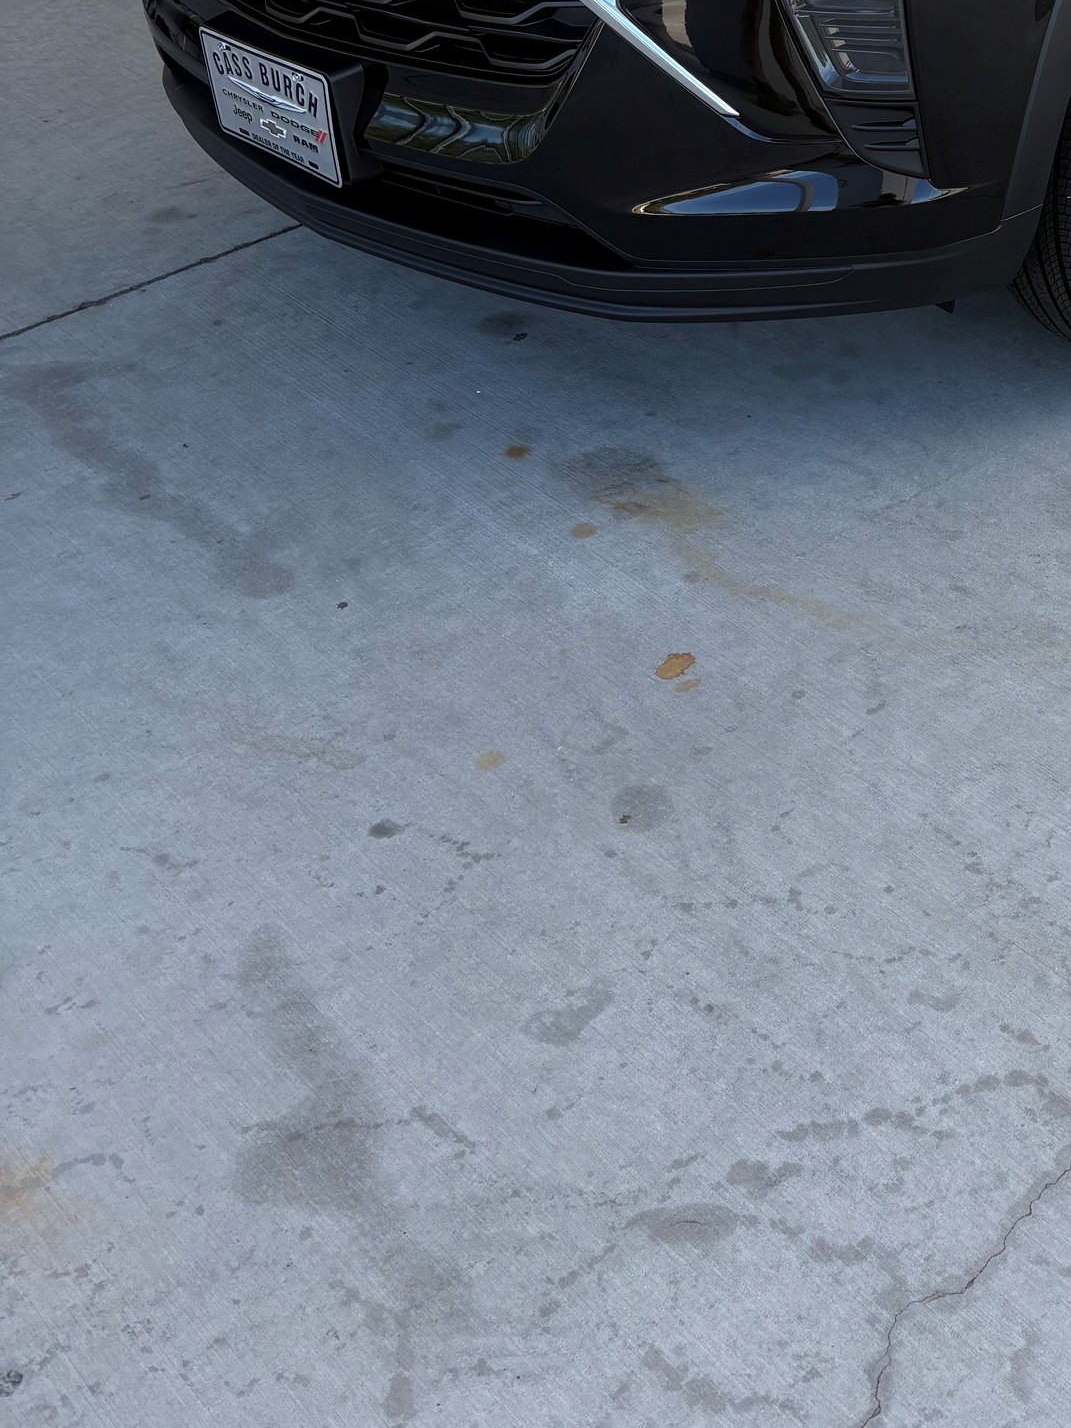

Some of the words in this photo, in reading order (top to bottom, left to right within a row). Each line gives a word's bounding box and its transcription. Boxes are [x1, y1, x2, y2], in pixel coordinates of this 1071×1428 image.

[212, 51, 253, 80] CASS
[258, 62, 319, 119] BURCH
[222, 88, 264, 113] CHRYSLER
[233, 104, 253, 124] Jeep
[270, 110, 318, 137] DODGE
[251, 132, 272, 147] DEALER
[272, 142, 279, 151] OF
[279, 145, 291, 157] THE
[291, 151, 304, 163] YEAR
[292, 134, 319, 154] RAM
